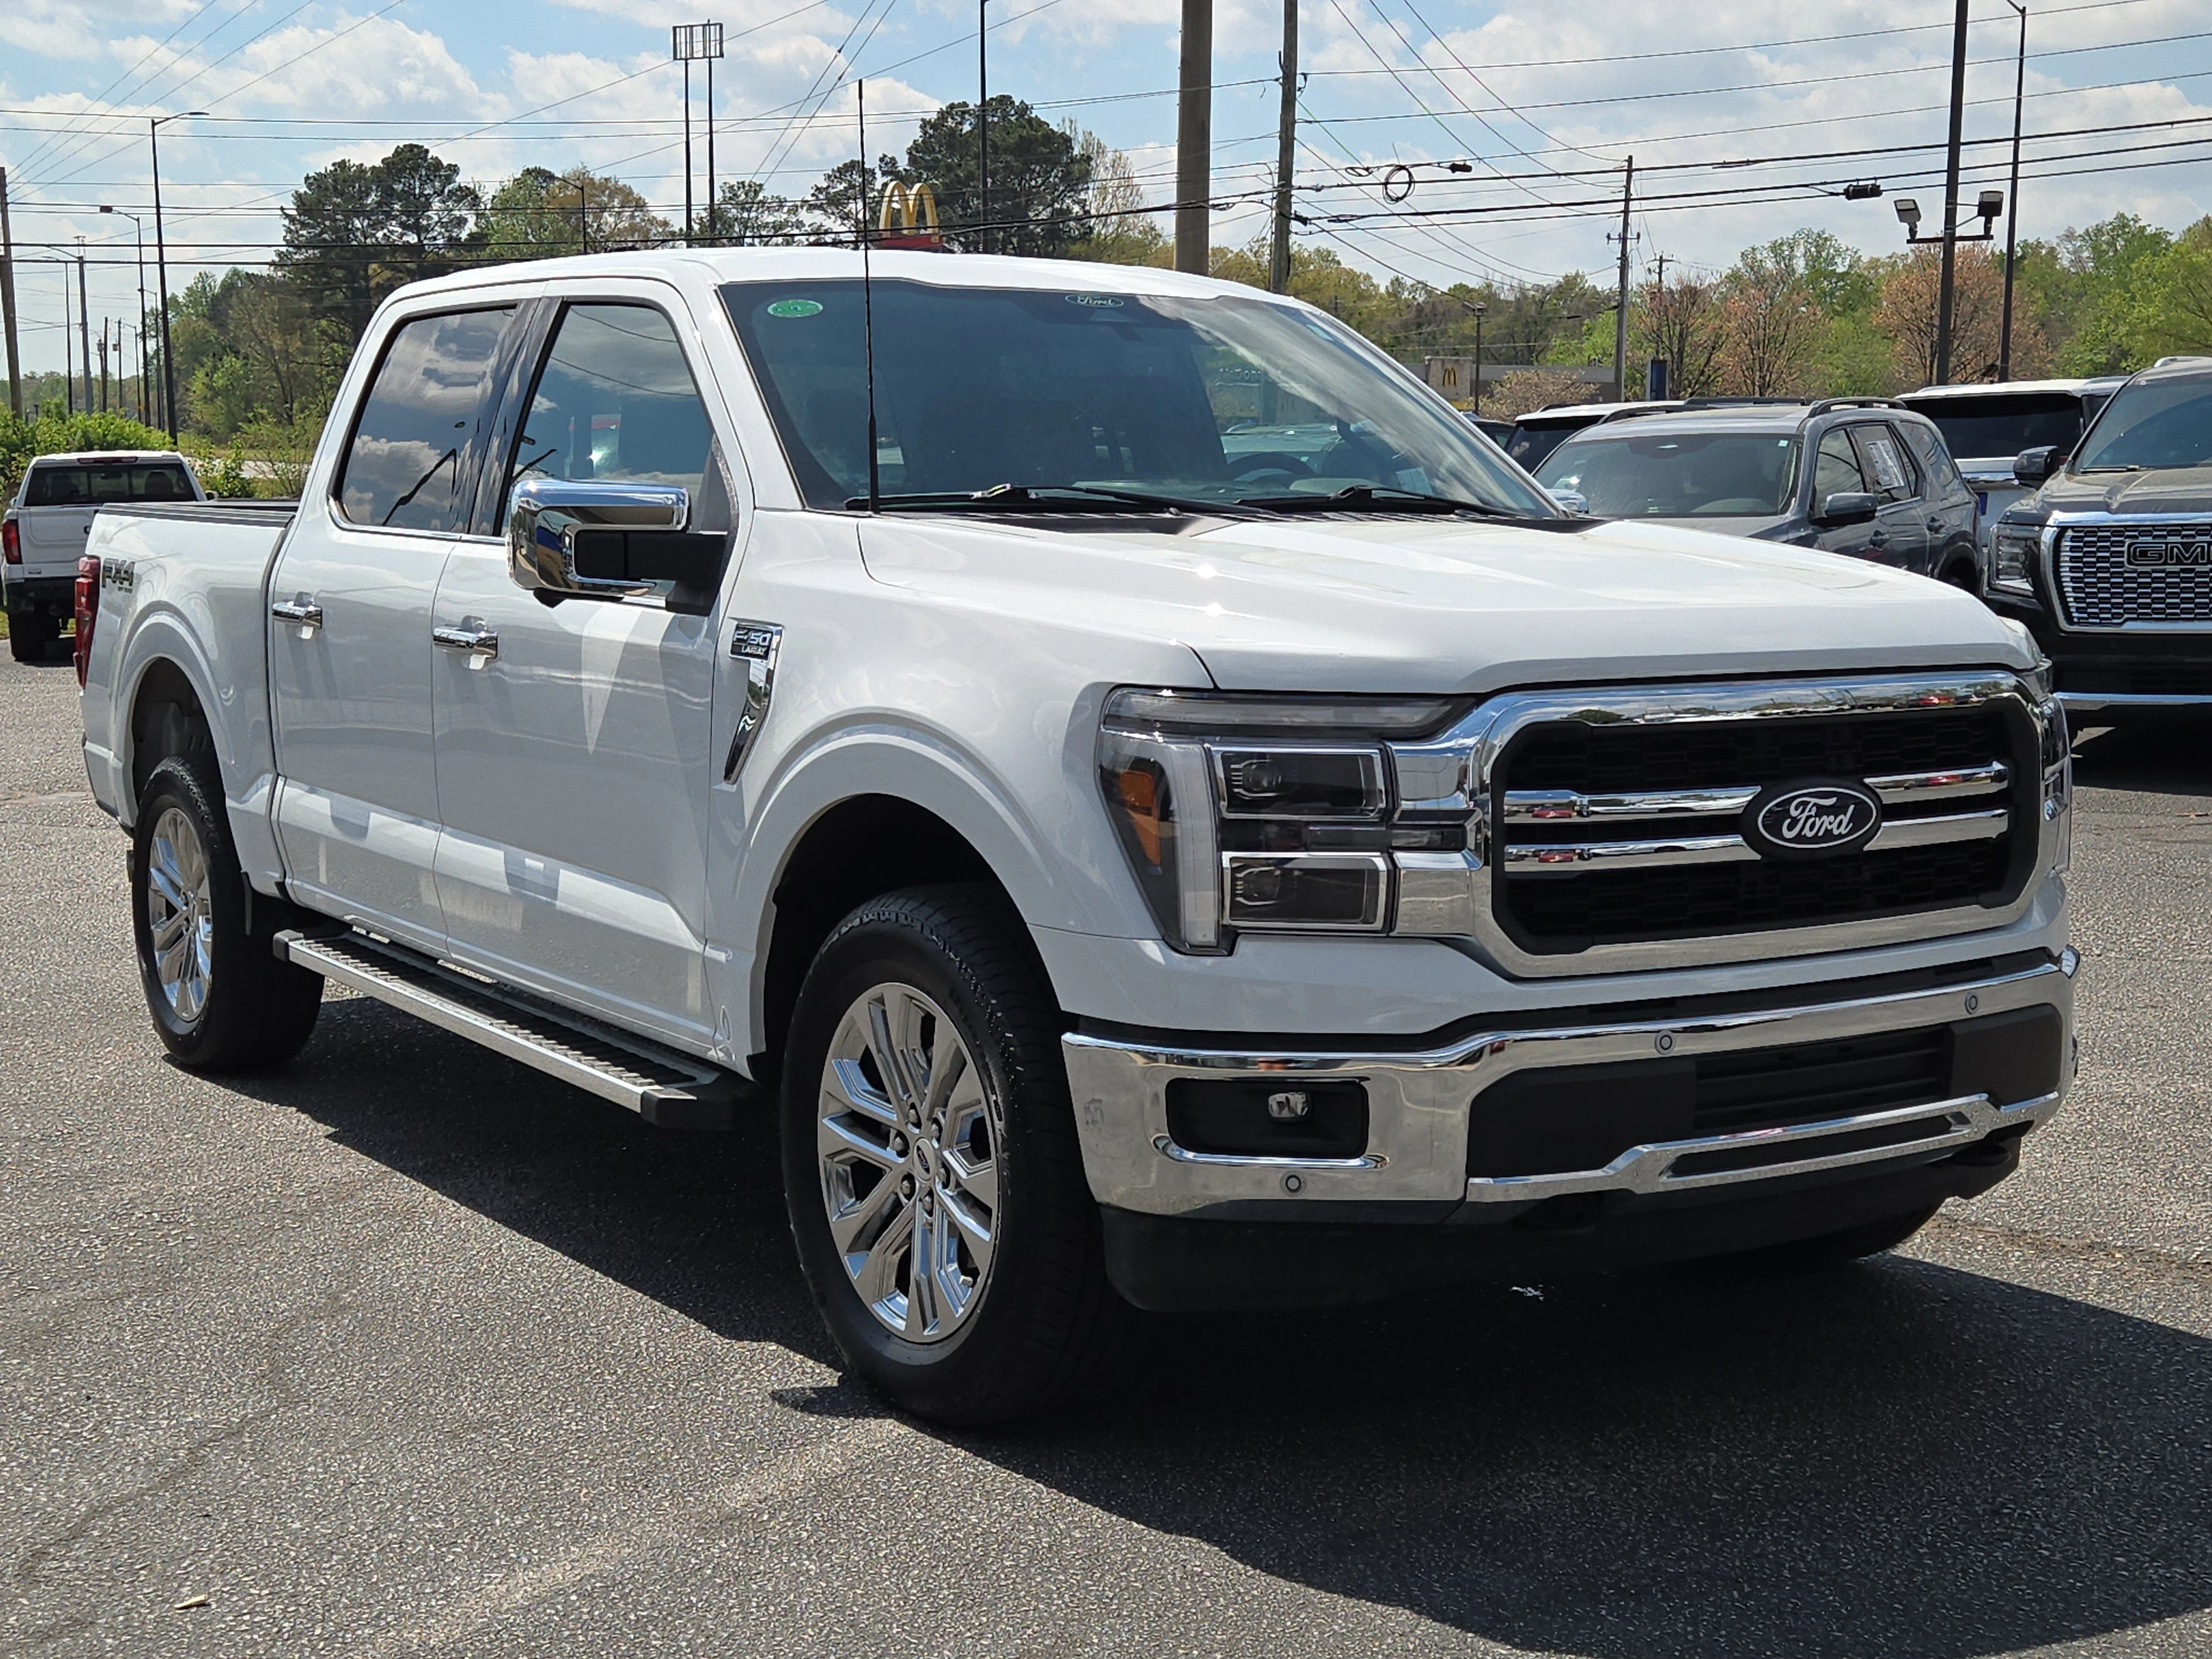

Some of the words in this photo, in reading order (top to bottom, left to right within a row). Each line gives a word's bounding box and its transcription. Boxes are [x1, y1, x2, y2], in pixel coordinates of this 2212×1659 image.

[2130, 543, 2212, 564] GM
[101, 558, 136, 588] FX4
[1782, 796, 1855, 839] Ford
